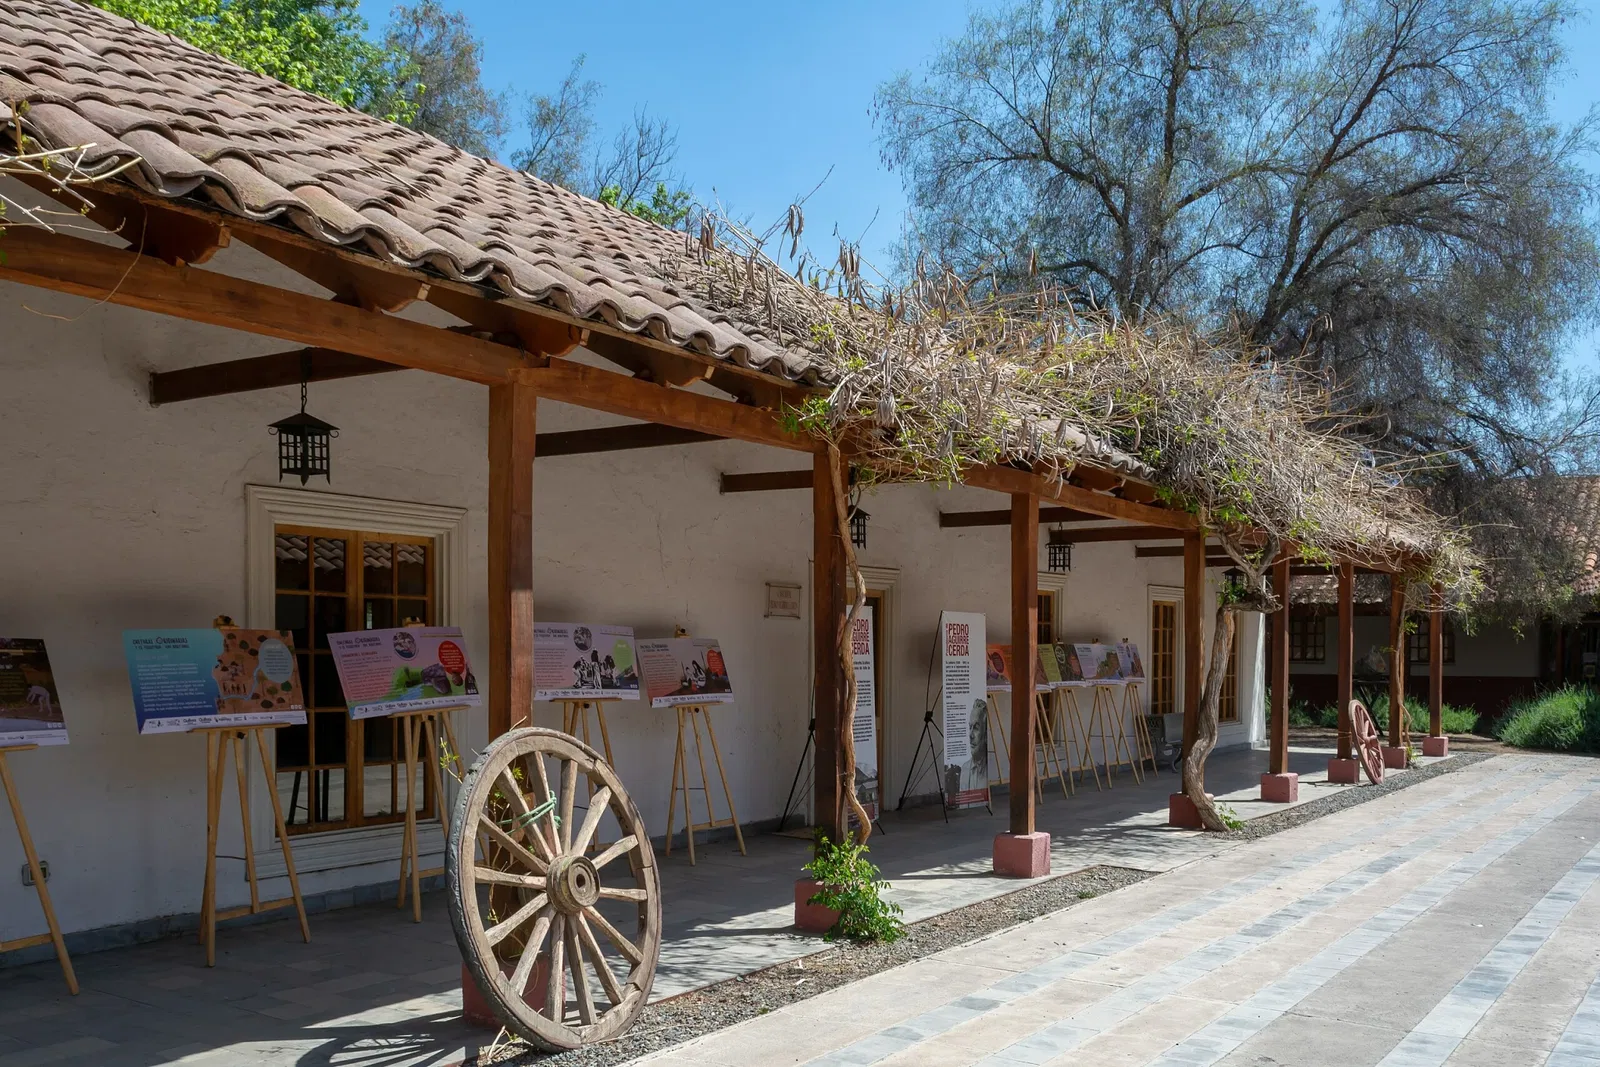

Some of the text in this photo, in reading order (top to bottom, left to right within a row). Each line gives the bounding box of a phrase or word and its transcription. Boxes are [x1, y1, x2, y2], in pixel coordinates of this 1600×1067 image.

[853, 619, 869, 632] EDRO
[948, 623, 969, 635] PEDRO
[852, 632, 870, 642] GUIRRE
[948, 635, 969, 645] AGUIRRE
[948, 644, 969, 656] CERDA
